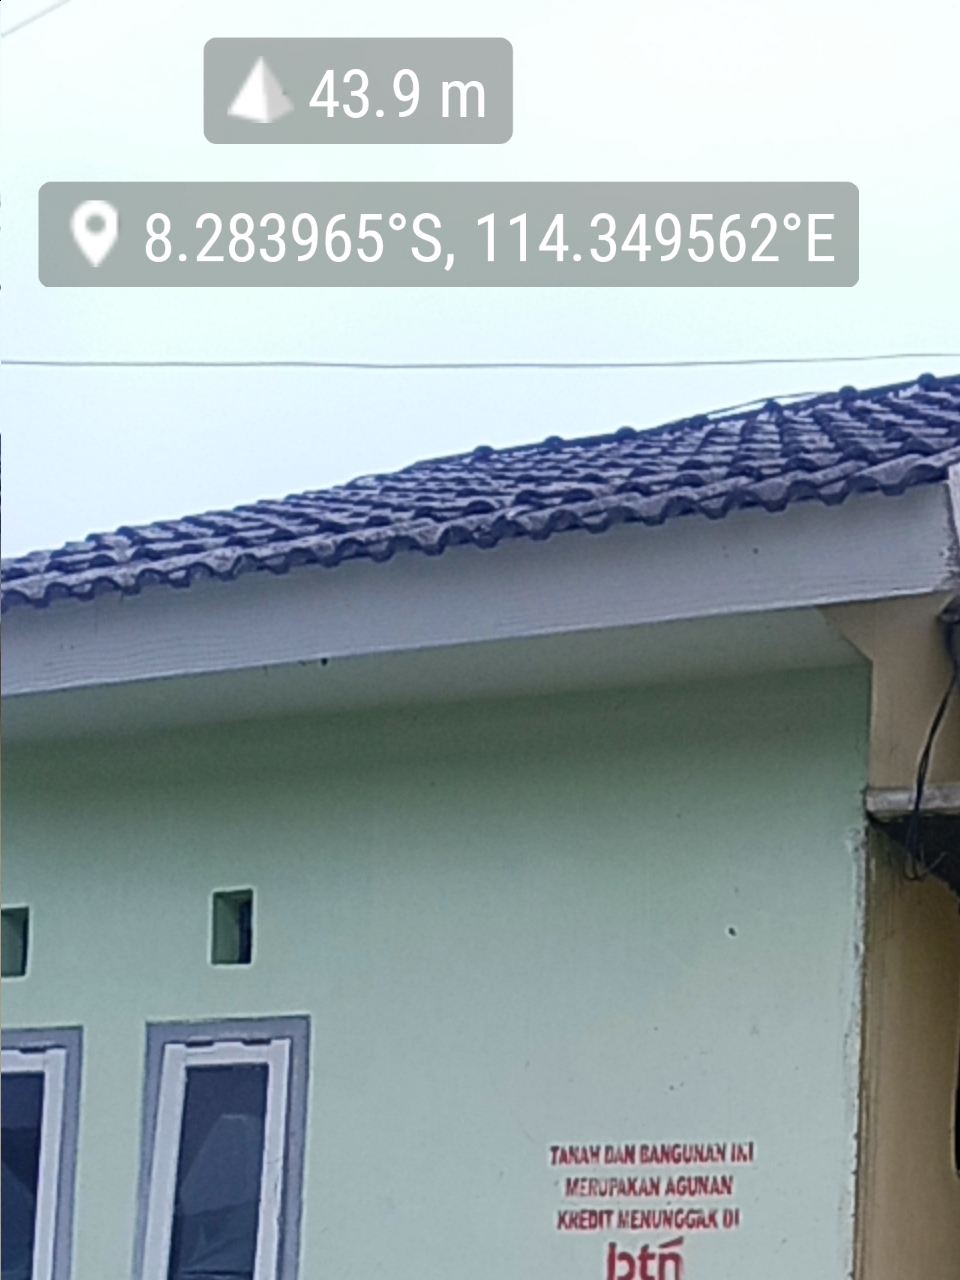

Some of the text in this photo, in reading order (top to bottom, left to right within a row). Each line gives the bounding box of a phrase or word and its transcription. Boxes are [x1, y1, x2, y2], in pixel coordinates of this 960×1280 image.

[551, 1145, 600, 1165] TANAH
[604, 1144, 636, 1164] DAN
[640, 1142, 728, 1164] BANGUNAN
[665, 1175, 733, 1196] AGUNAN
[557, 1208, 614, 1230] KREDIT
